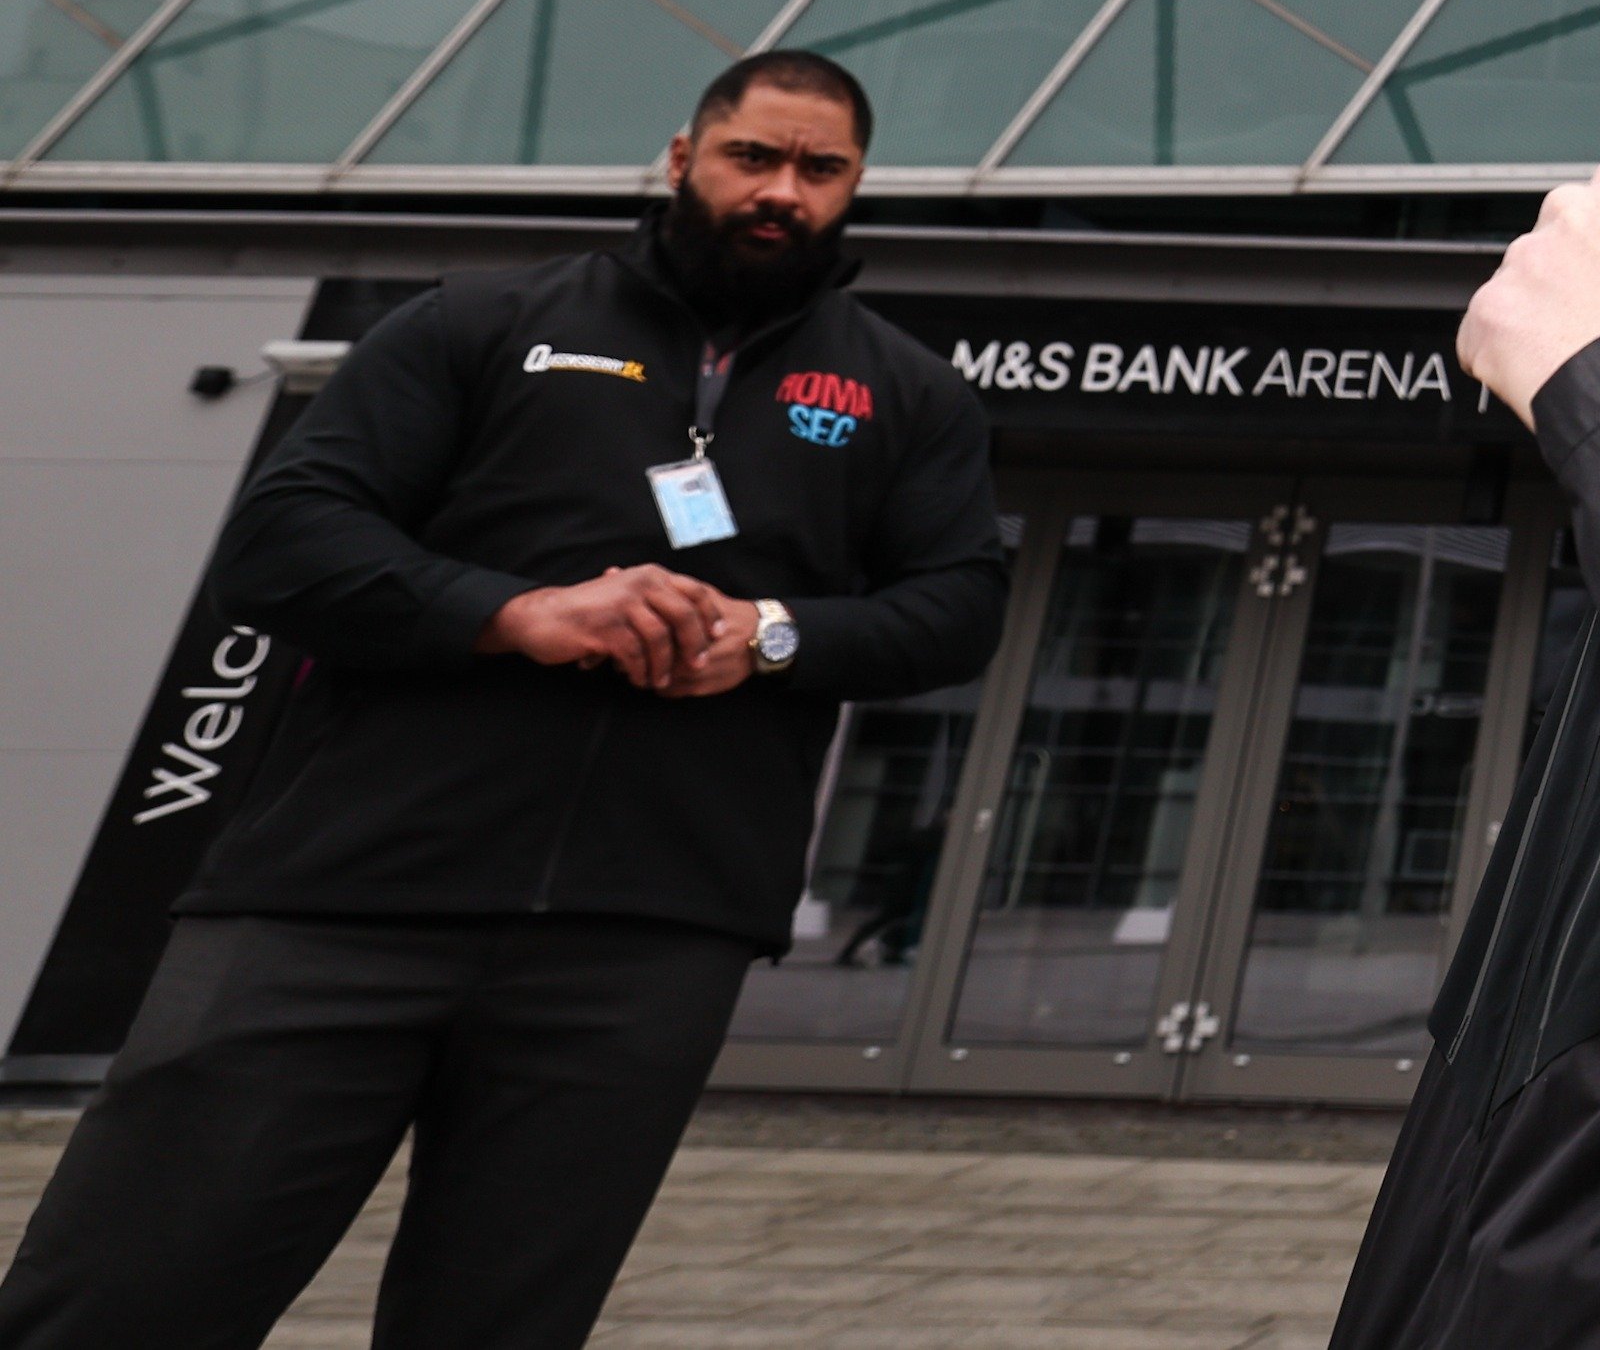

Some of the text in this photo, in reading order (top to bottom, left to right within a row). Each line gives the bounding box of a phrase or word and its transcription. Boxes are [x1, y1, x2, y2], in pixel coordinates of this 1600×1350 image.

[951, 338, 1453, 402] M&S BANK ARENA
[787, 403, 858, 448] SEC
[132, 625, 272, 826] Welc
